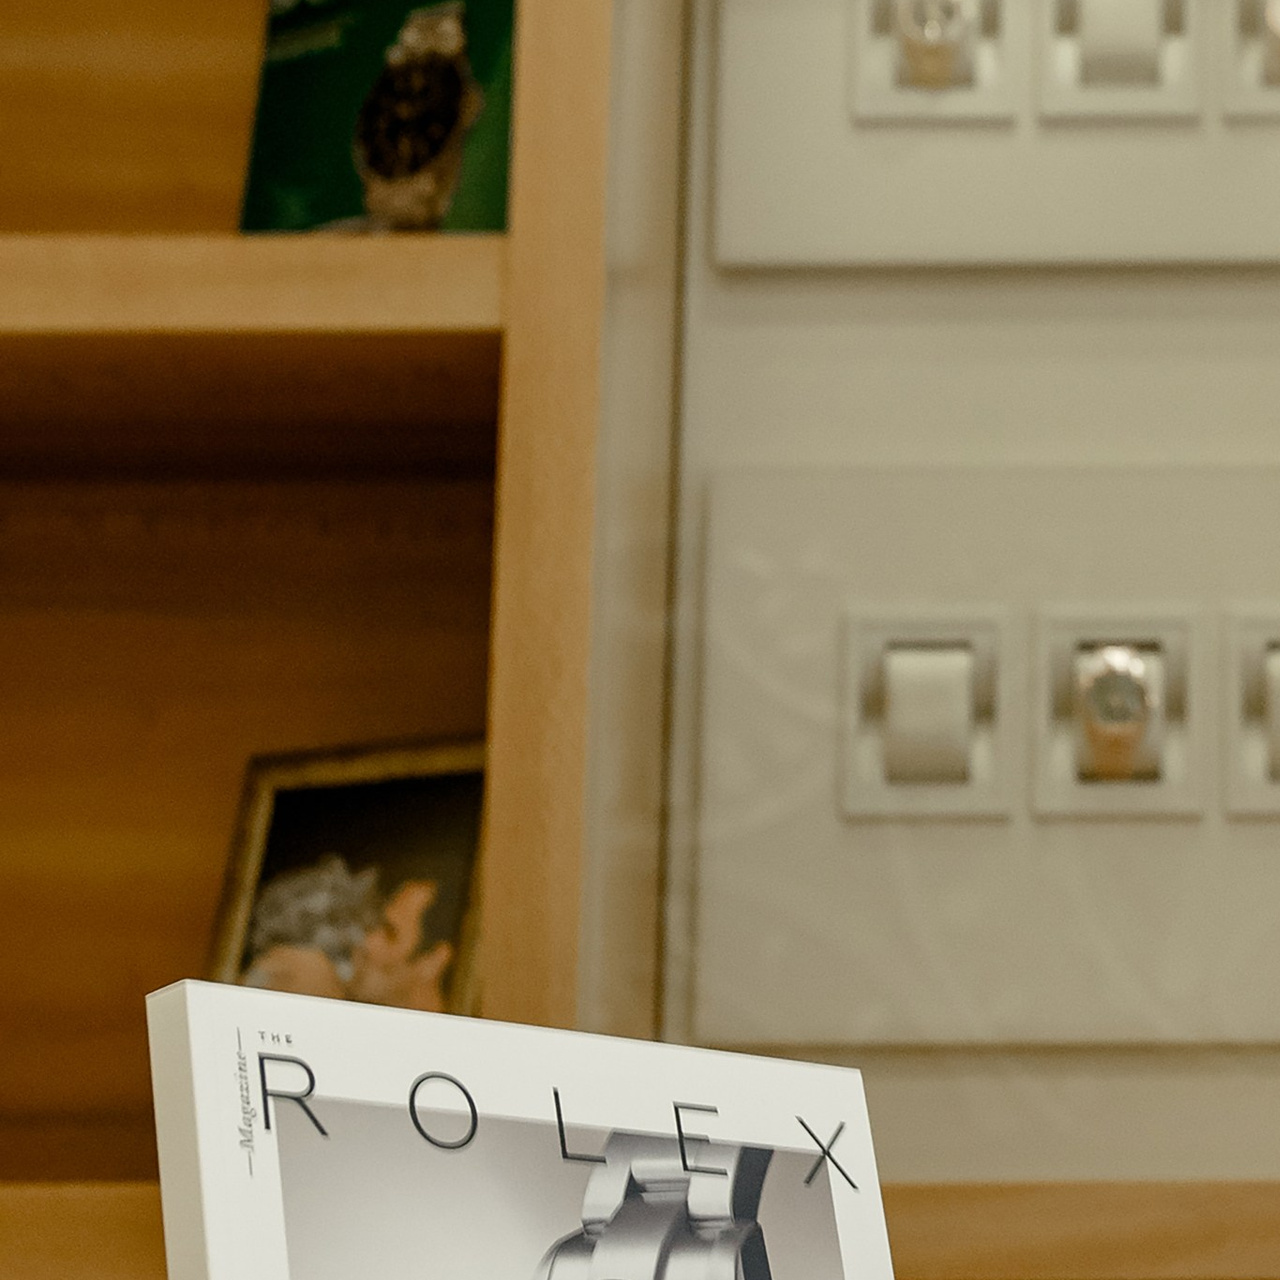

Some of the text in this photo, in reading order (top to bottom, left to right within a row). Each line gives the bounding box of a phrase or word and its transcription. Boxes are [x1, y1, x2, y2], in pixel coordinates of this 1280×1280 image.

[257, 1031, 293, 1045] THE
[234, 1051, 257, 1154] Magazine
[257, 1051, 858, 1190] ROLEX
